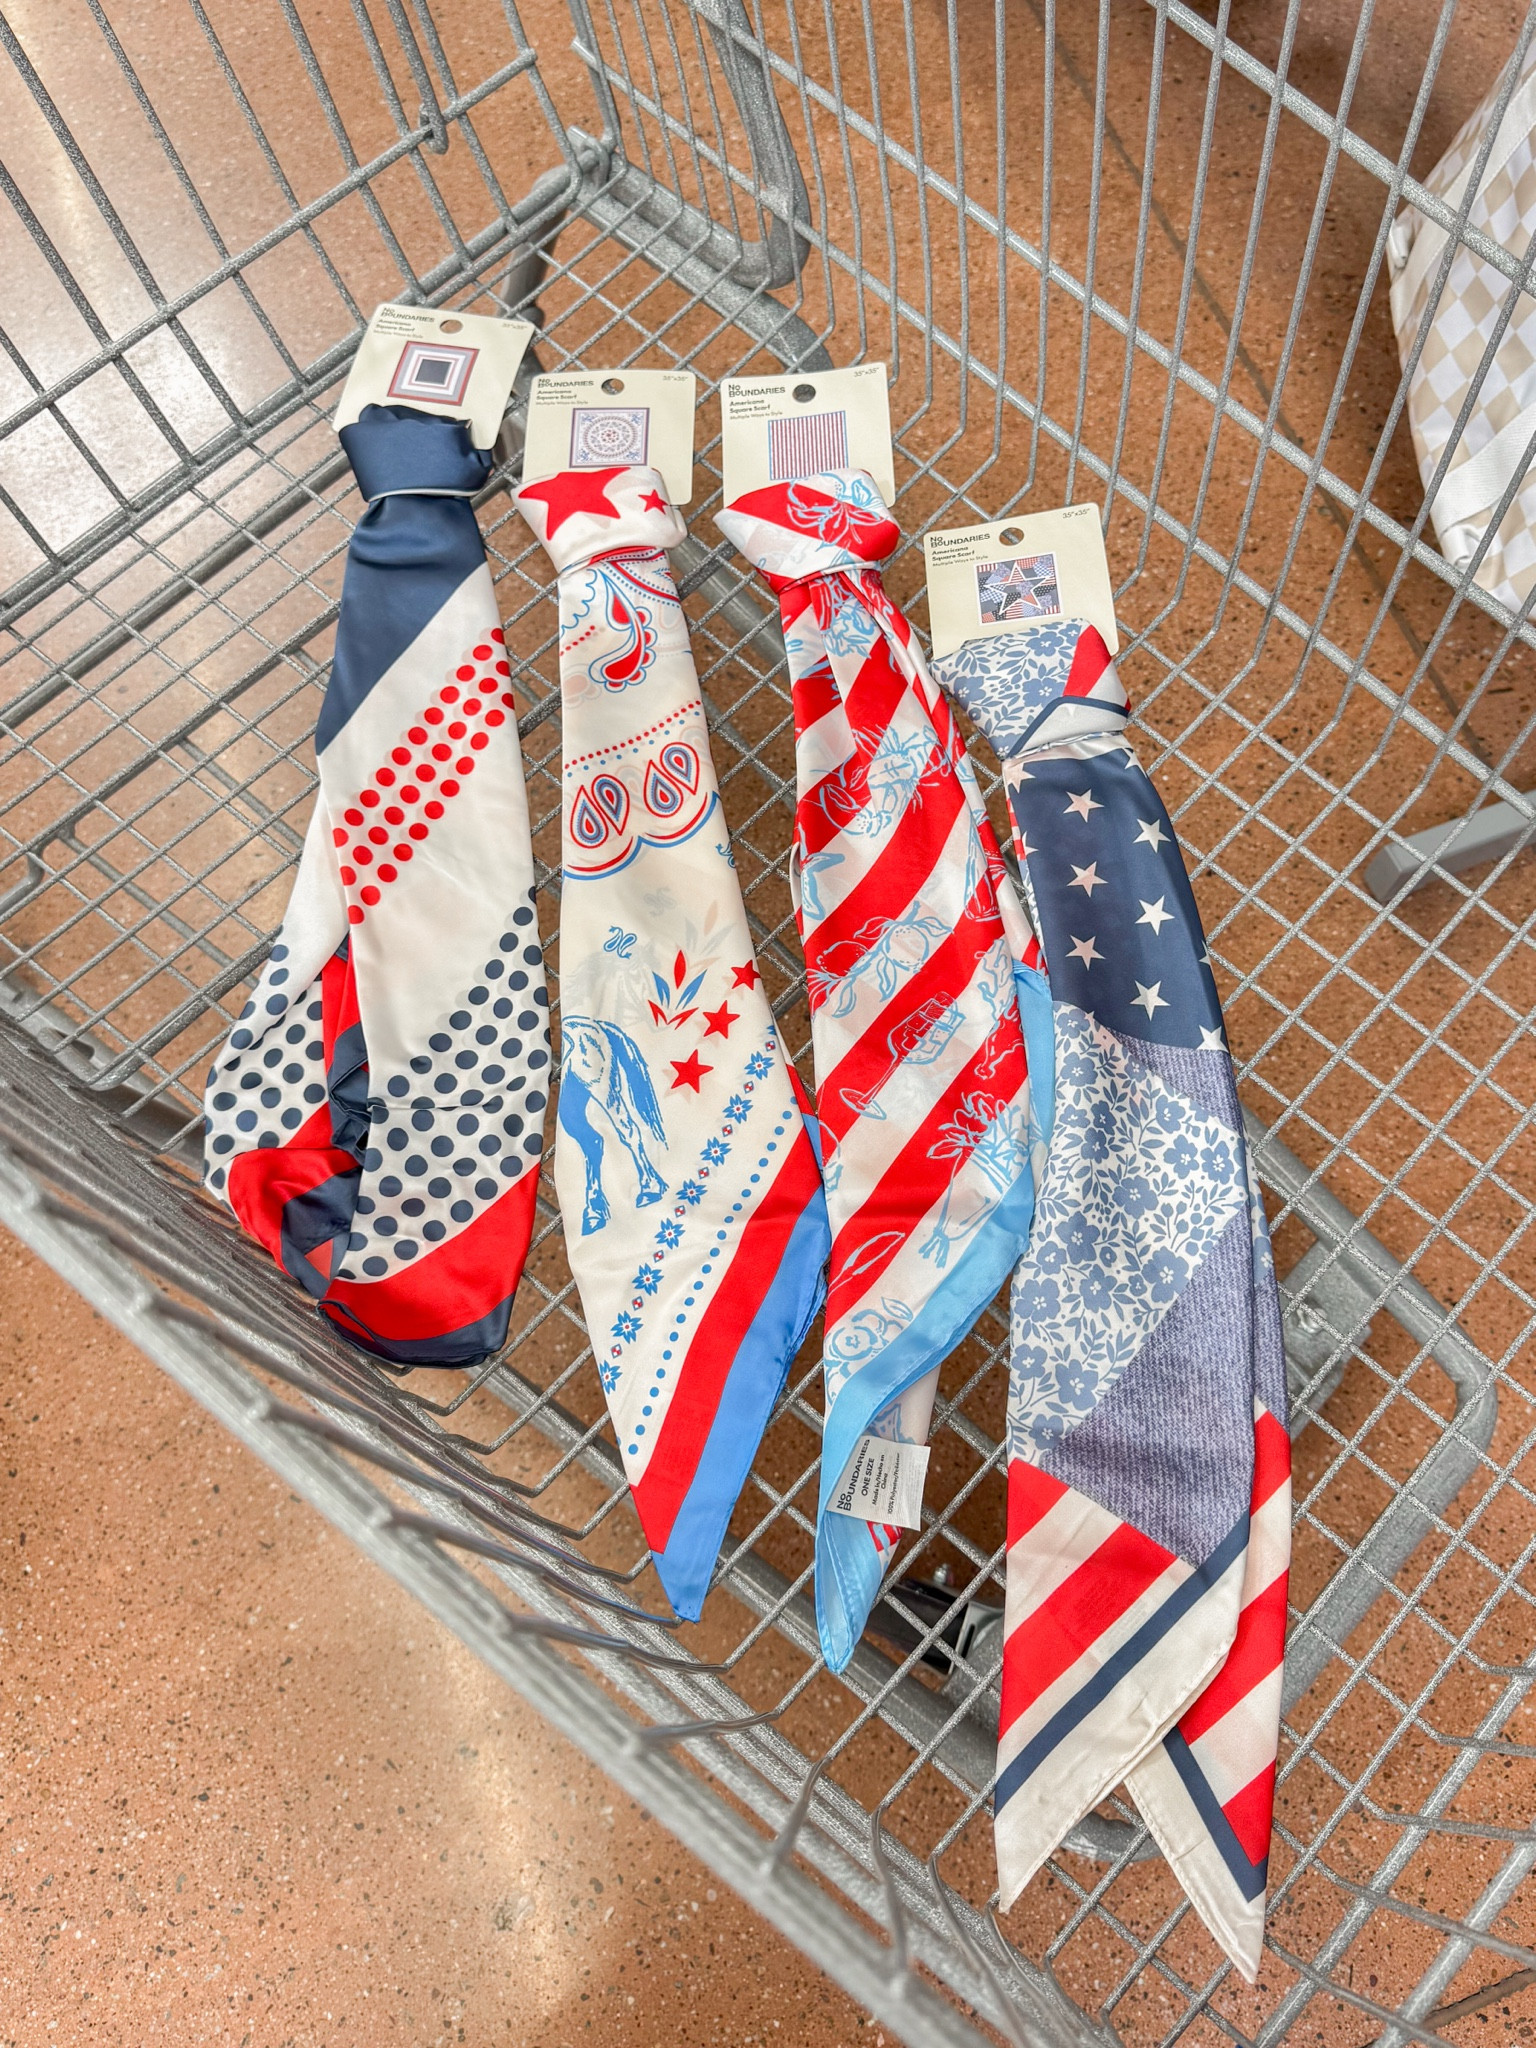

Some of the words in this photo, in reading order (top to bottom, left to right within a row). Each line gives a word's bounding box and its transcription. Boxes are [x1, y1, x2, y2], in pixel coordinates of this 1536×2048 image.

[381, 312, 435, 322] BOUNDARIES
[729, 387, 786, 397] BOUNDARIES
[931, 533, 990, 548] BOUNDARIES
[932, 546, 968, 555] Americana
[843, 1440, 870, 1511] BOUNDARIES
[861, 1477, 870, 1496] ONE
[866, 1458, 875, 1477] SIZE
[836, 1493, 846, 1509] NO
